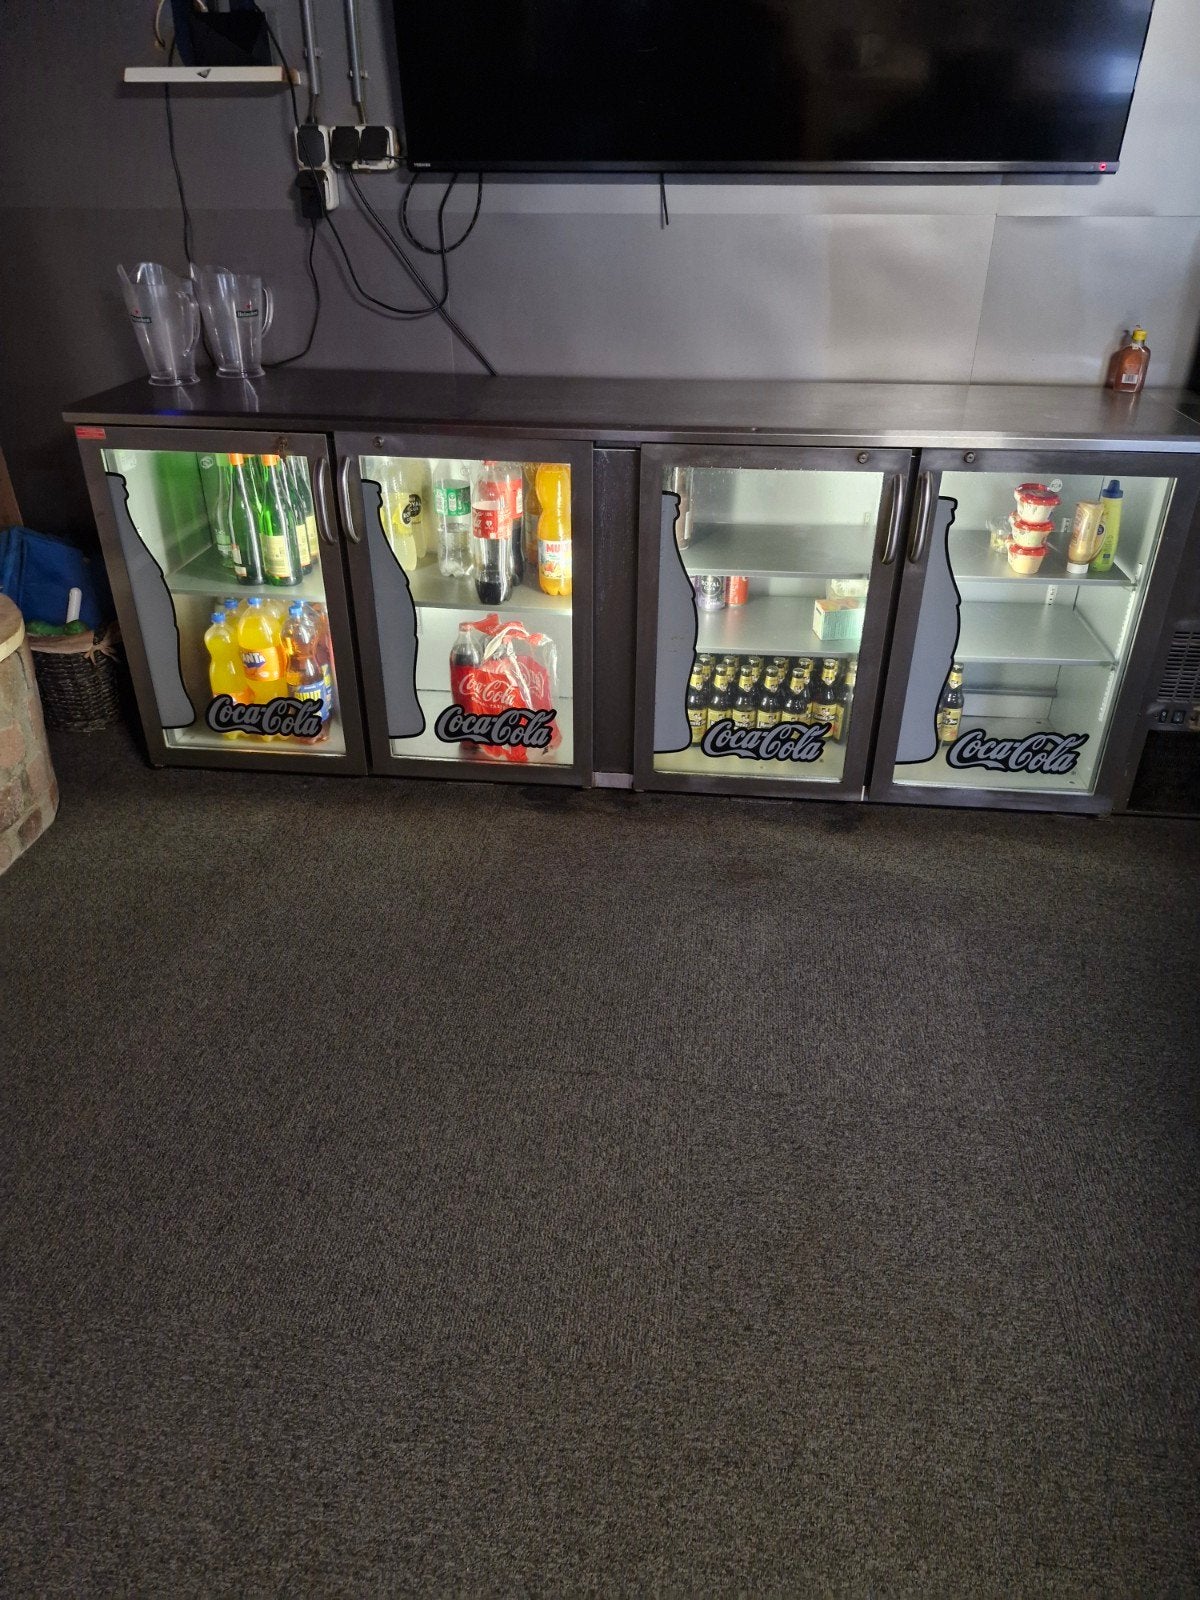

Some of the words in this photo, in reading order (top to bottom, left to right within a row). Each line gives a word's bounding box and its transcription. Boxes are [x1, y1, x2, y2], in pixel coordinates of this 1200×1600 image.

[207, 695, 322, 736] Coca-Cola
[436, 705, 556, 747] Coca-Cola
[702, 719, 831, 761] Coca-Cola
[948, 730, 1089, 773] Coca-Cola
